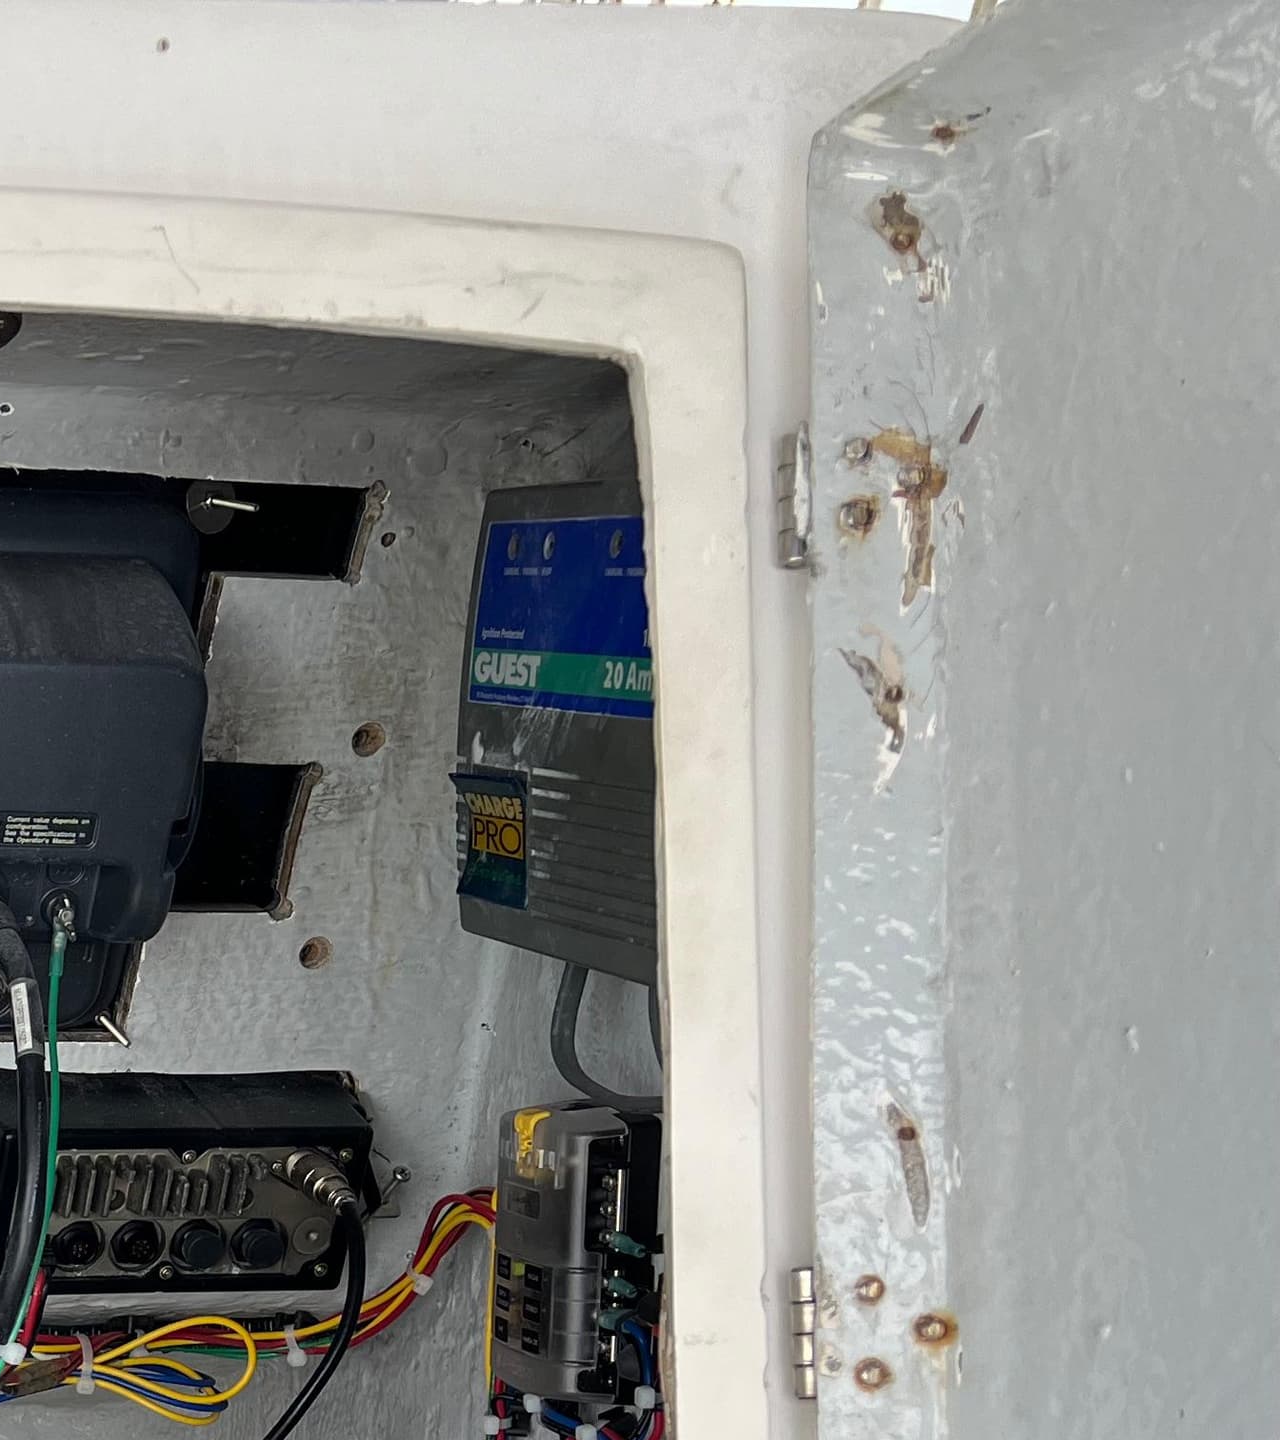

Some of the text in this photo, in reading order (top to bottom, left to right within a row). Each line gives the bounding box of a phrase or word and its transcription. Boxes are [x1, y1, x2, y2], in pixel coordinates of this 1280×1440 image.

[474, 651, 653, 693] GUEST 20 Am
[463, 792, 523, 820] CHARGE
[473, 817, 522, 855] PRO
